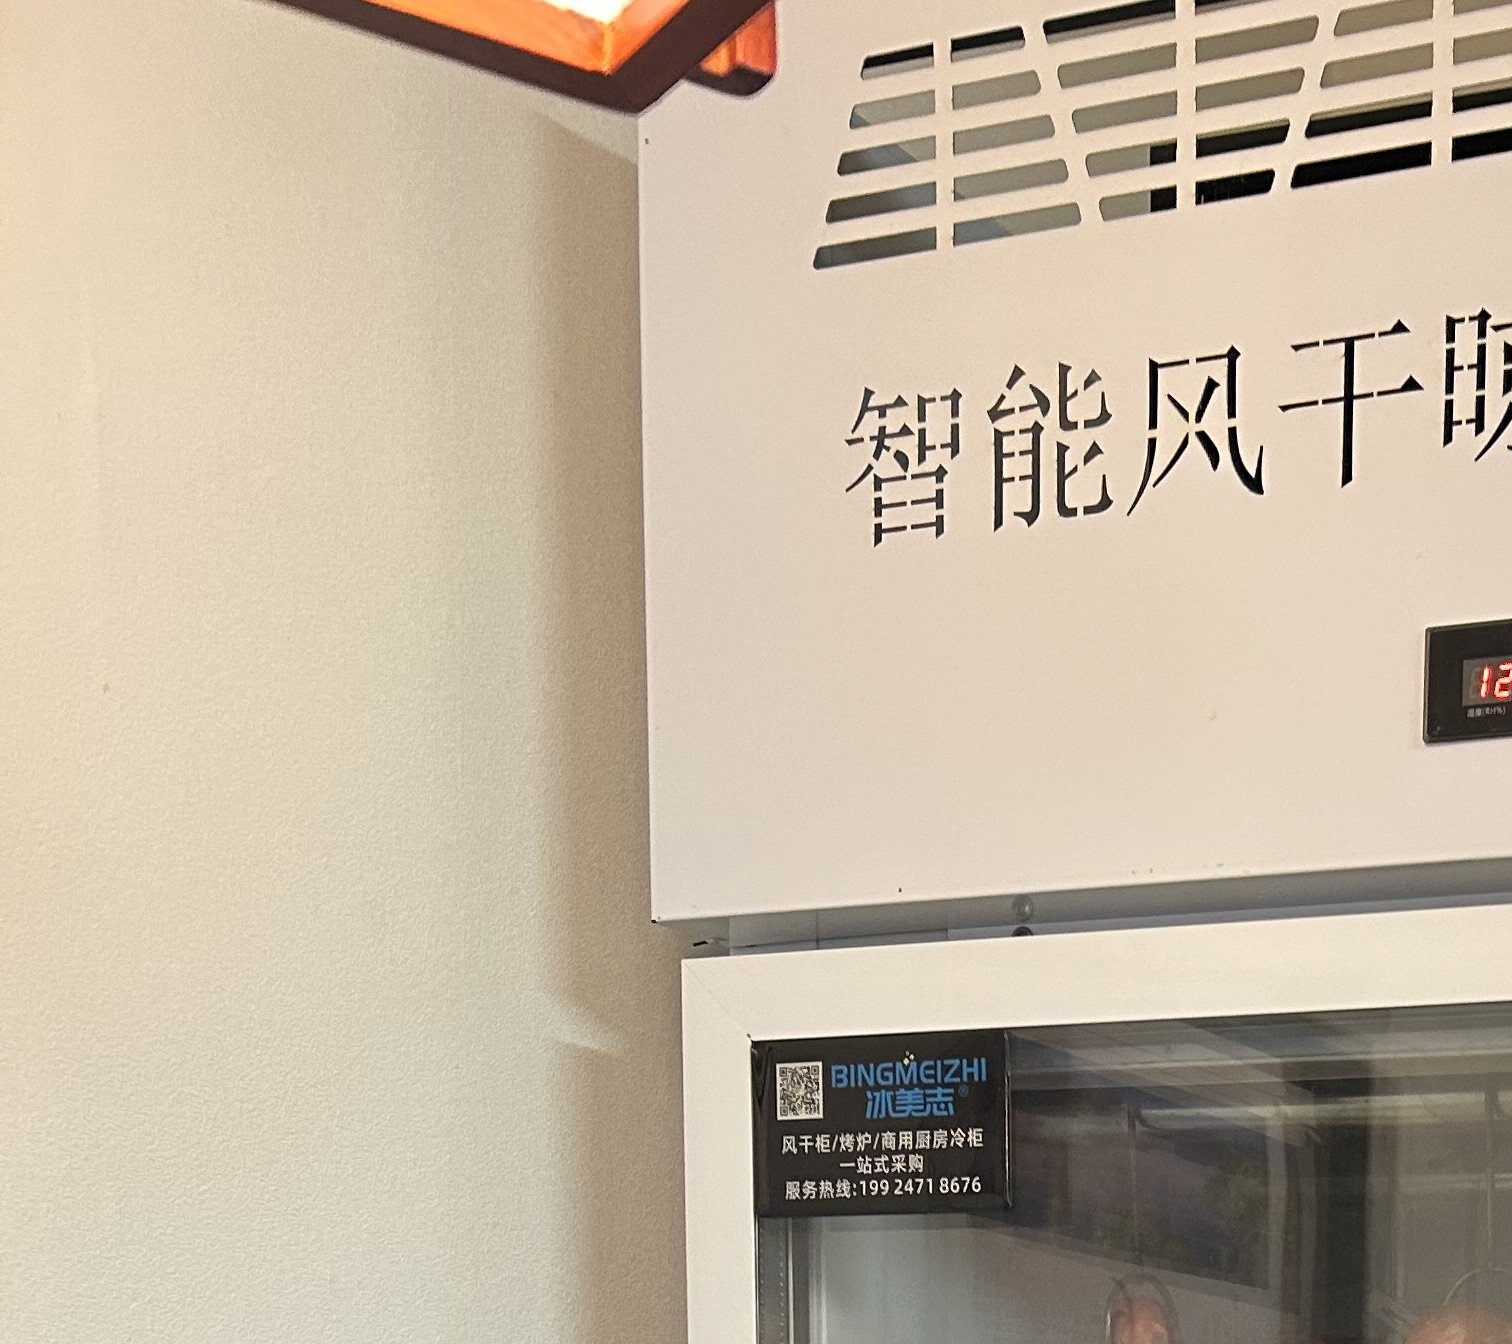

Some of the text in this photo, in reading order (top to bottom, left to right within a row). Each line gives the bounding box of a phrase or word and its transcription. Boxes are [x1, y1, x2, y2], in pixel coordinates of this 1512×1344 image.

[831, 1057, 987, 1089] BINGMEIZHI
[781, 1127, 984, 1155] 风干柜/烤炉/商用厨房冷柜
[839, 1153, 925, 1175] 一站式采购
